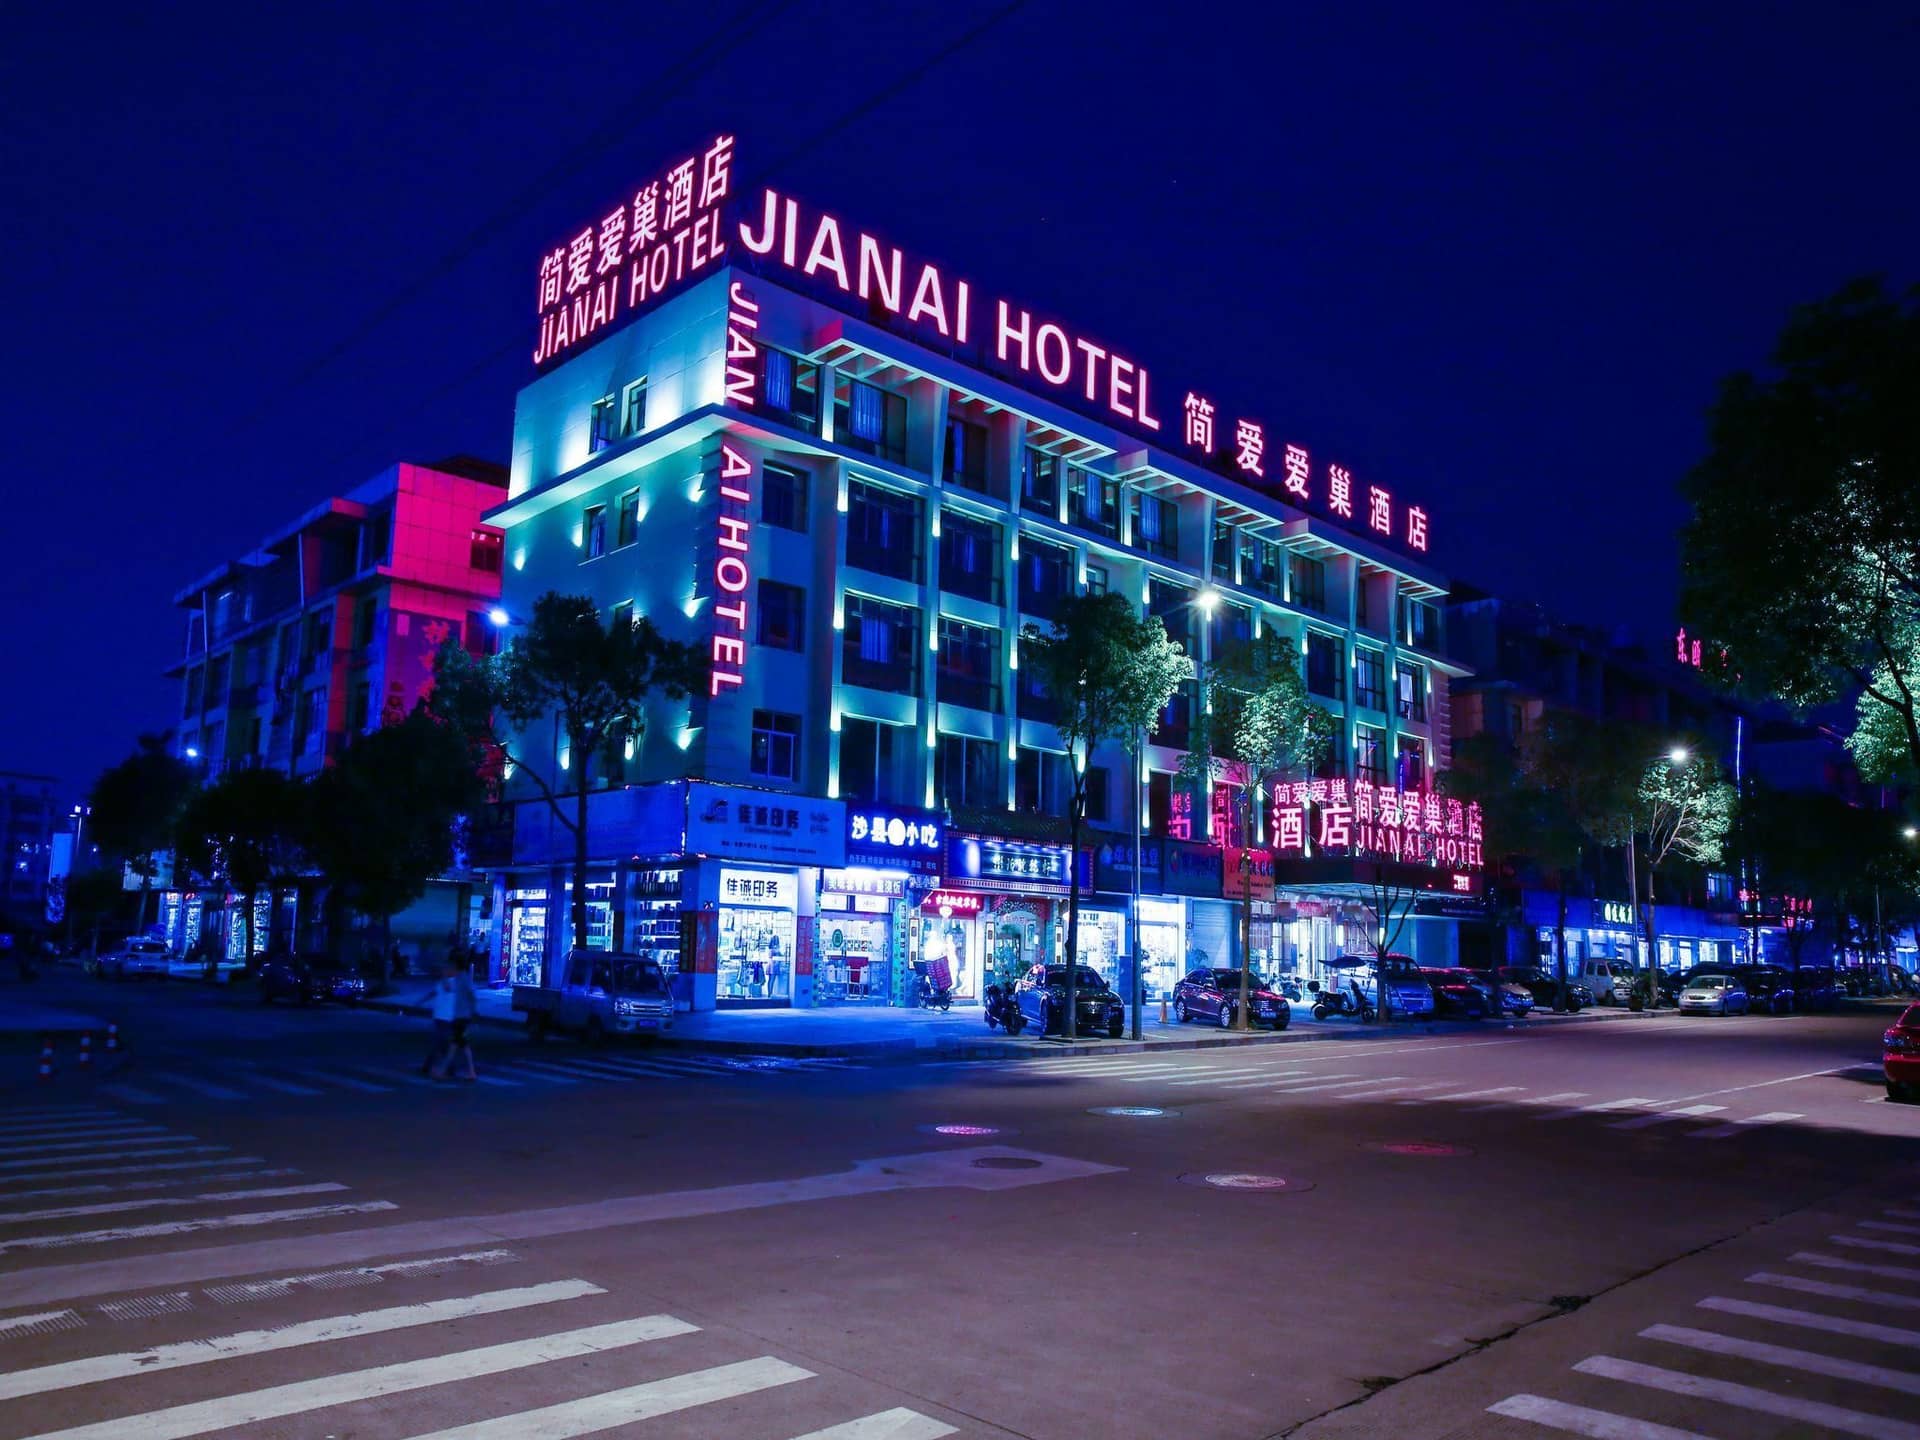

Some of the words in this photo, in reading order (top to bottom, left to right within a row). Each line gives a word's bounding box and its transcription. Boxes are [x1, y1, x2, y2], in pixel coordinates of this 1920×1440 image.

[538, 135, 734, 314] 简爱爱巢酒店
[534, 272, 619, 365] JIANAI
[630, 208, 725, 308] HOTEL
[739, 188, 969, 344] JIANAI
[998, 300, 1161, 431] HOTEL
[724, 281, 760, 406] JIAN
[720, 445, 752, 501] AI
[1185, 391, 1428, 552] 简爱爱巢酒店
[711, 516, 750, 697] HOTEL
[1271, 803, 1353, 849] 酒店
[1274, 778, 1348, 806] 简爱爱巢
[1354, 778, 1484, 841] 简爱爱巢酒店
[727, 877, 778, 898] 佳诚印务
[1355, 824, 1423, 859] JIANAI
[1435, 836, 1485, 866] HOTEL
